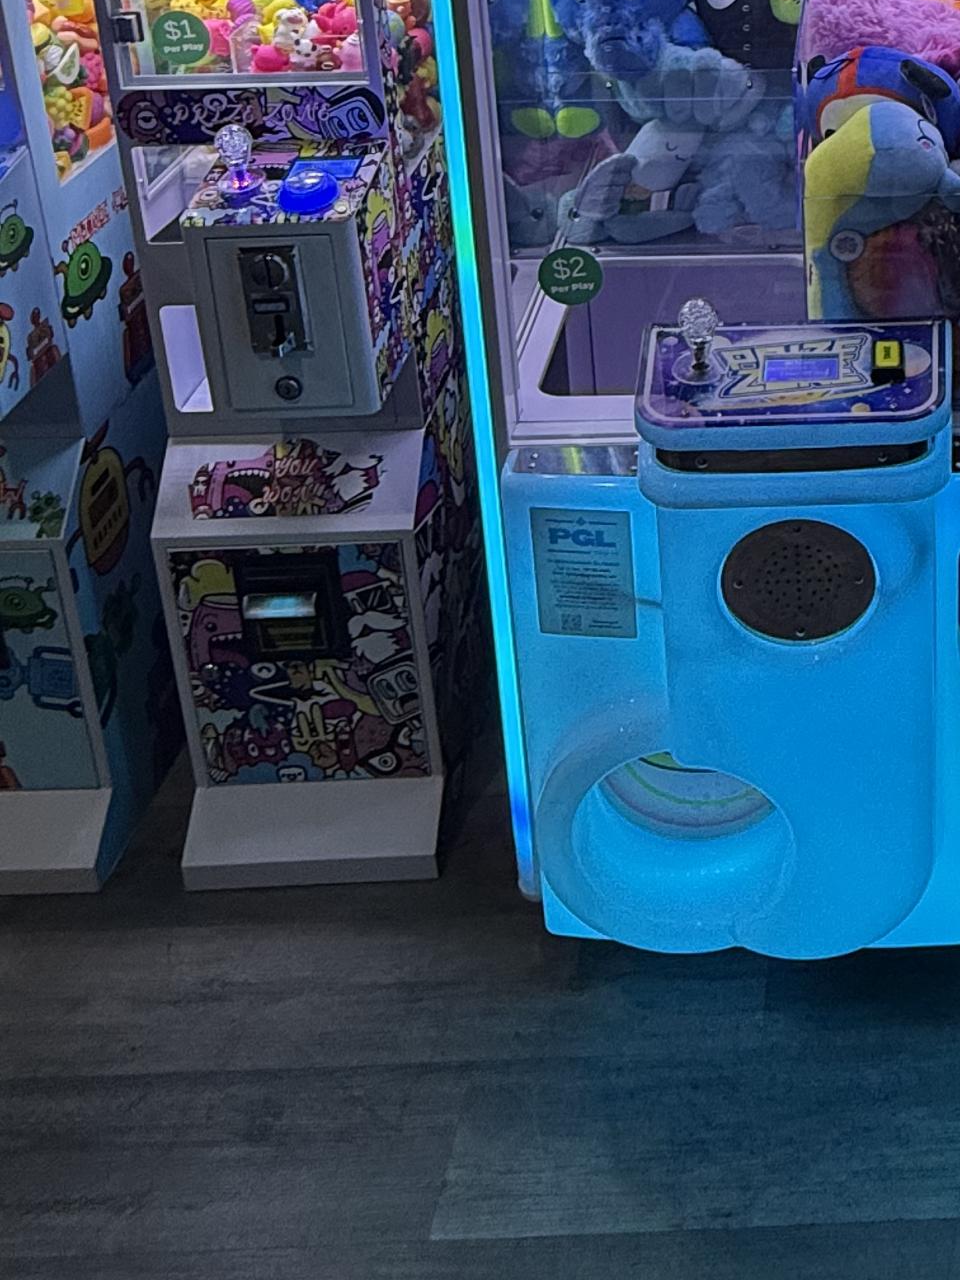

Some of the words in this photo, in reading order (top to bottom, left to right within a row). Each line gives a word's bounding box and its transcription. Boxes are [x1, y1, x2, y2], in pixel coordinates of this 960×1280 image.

[163, 18, 197, 41] $1
[163, 45, 181, 55] Per
[182, 43, 205, 54] Play
[173, 102, 254, 127] PRIZE
[263, 102, 332, 126] ZONE
[552, 256, 586, 280] $2
[551, 283, 577, 294] Per
[577, 281, 596, 293] Play
[548, 528, 617, 547] PGL
